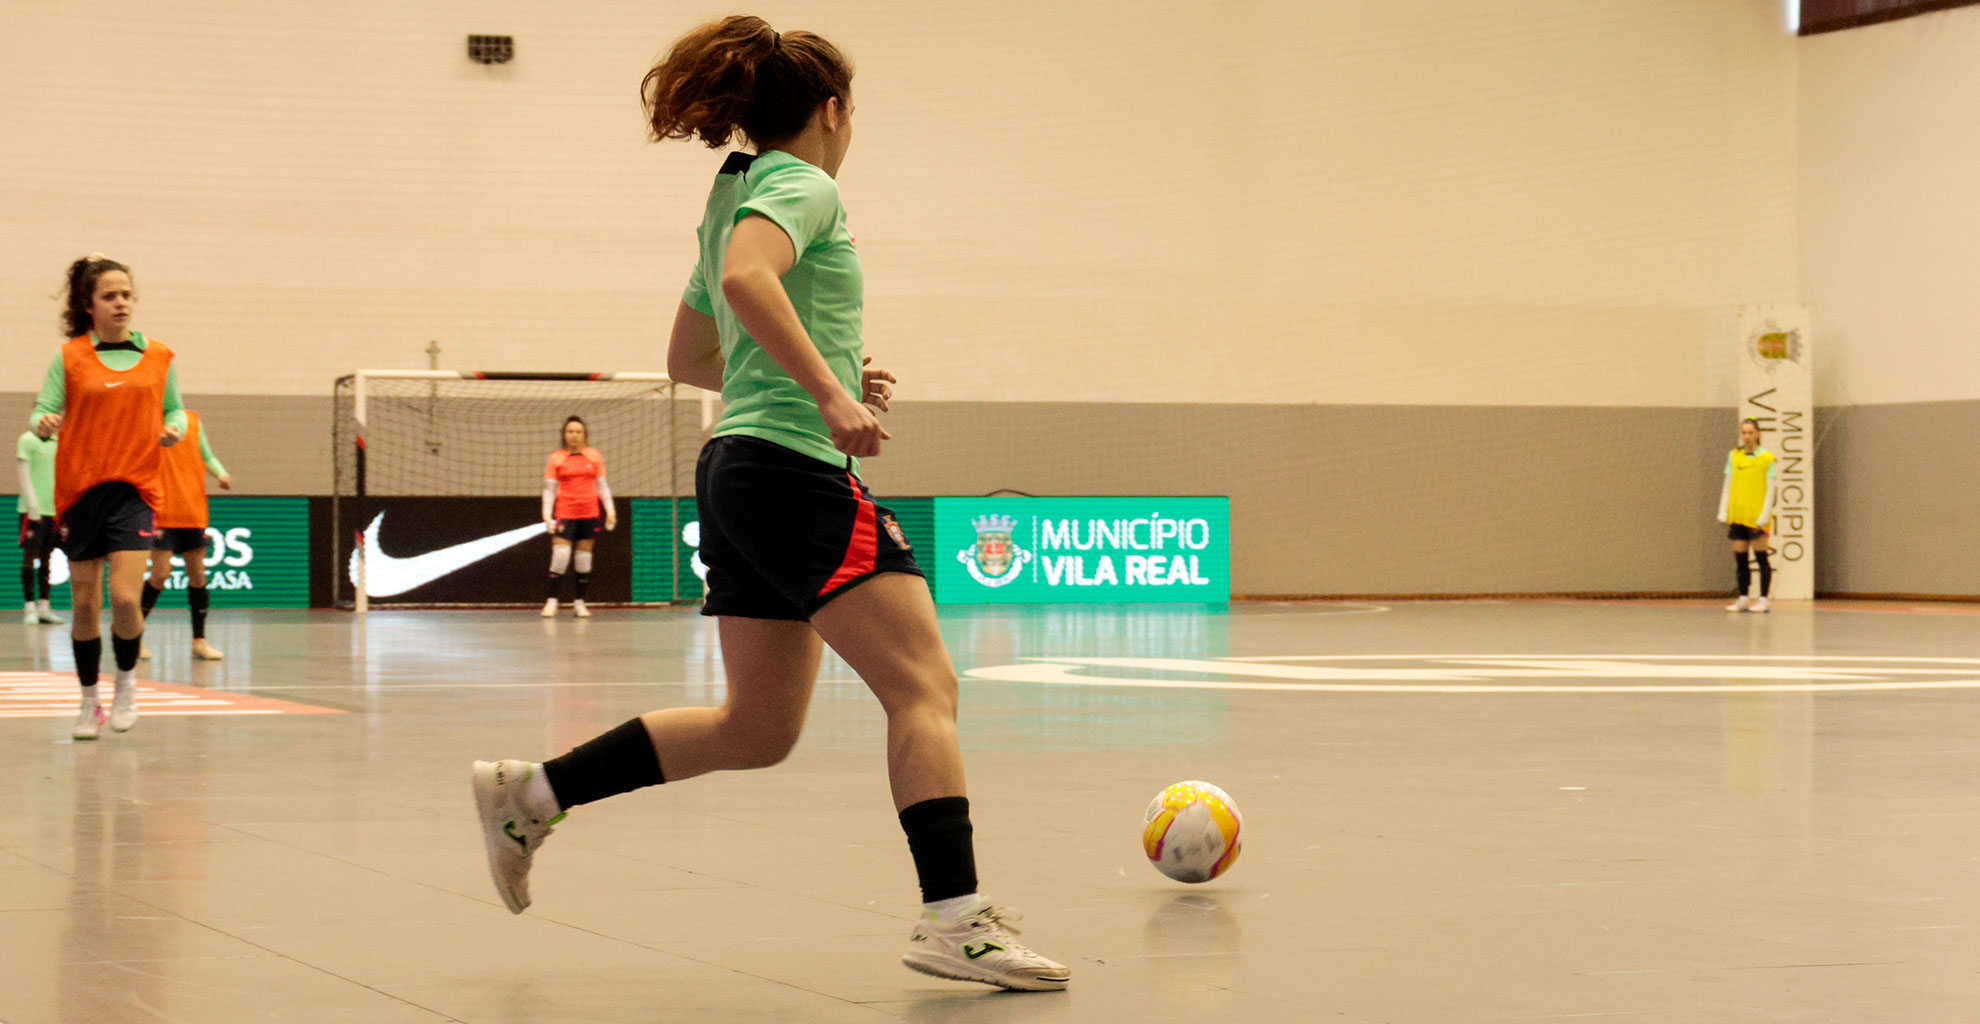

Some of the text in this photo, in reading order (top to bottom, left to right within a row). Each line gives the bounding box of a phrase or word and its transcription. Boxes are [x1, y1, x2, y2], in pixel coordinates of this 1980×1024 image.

[1781, 411, 1808, 562] MUNICÍPIO
[1041, 511, 1210, 550] MUNICÍPIO
[1041, 555, 1210, 586] VILA REAL
